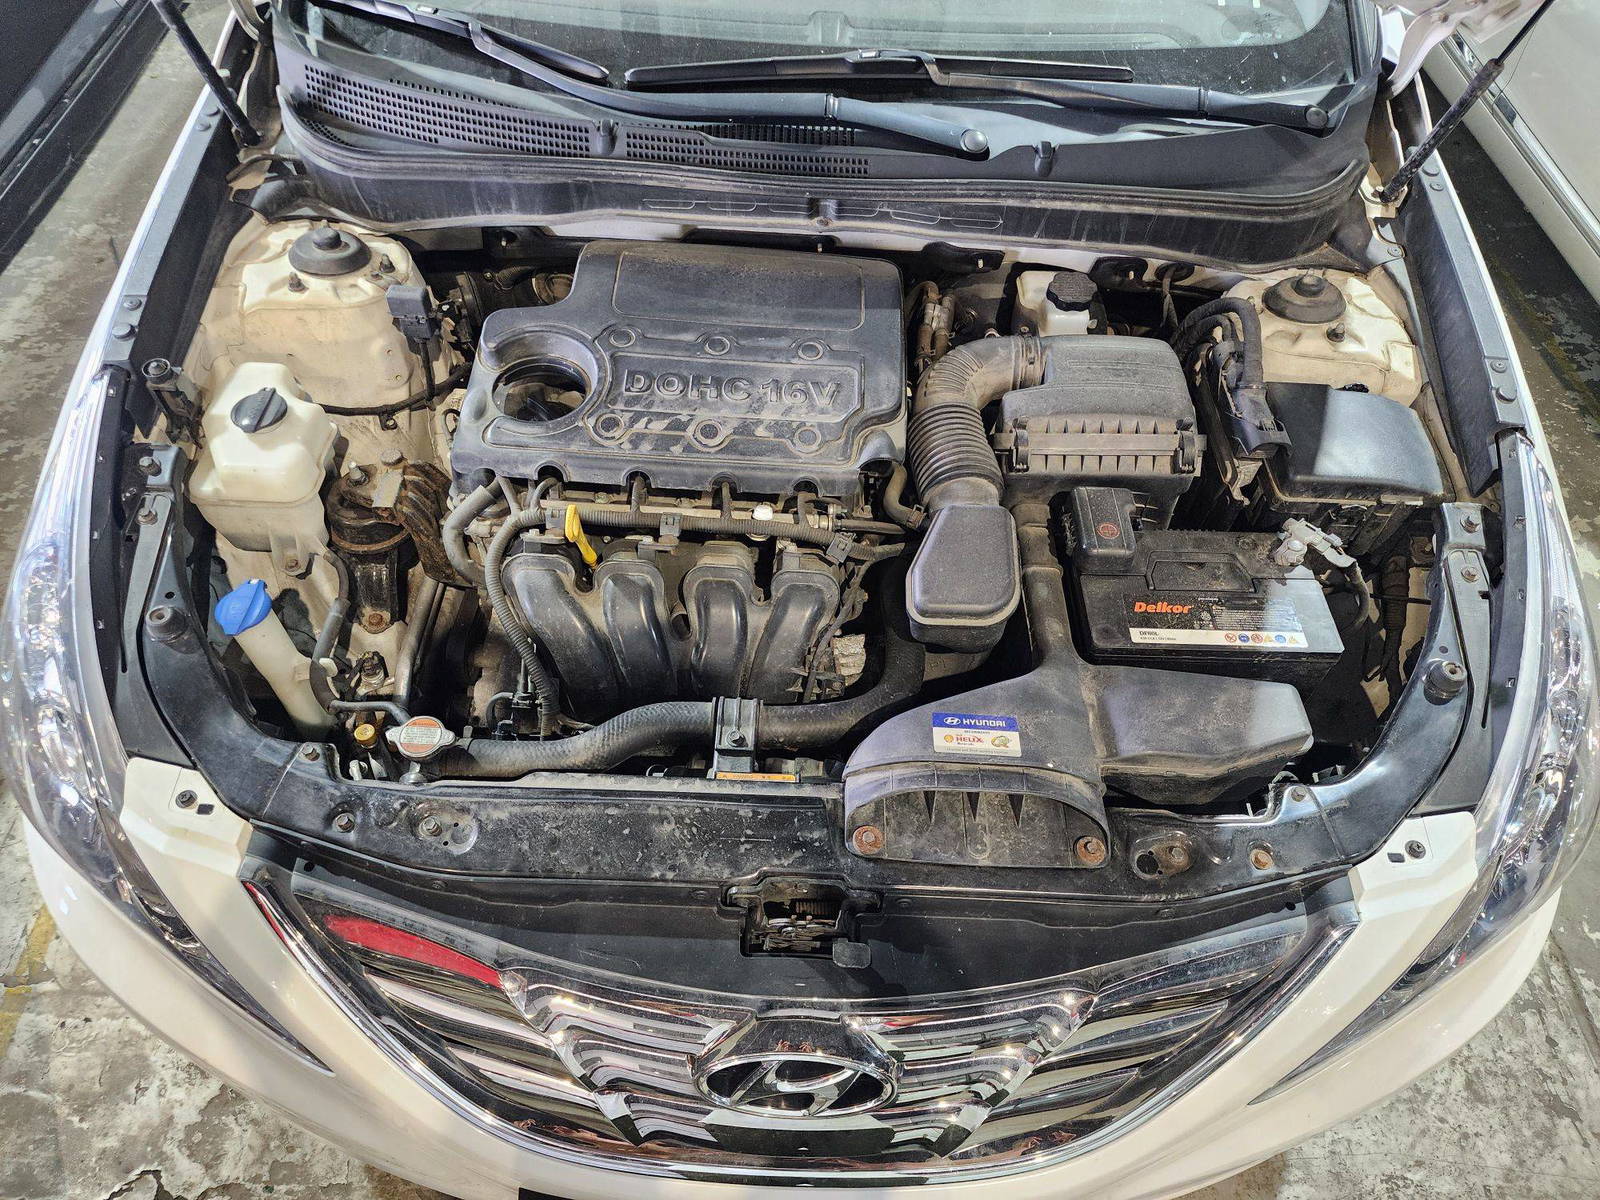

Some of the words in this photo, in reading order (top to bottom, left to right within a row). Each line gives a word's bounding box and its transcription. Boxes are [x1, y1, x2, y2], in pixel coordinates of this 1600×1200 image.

[623, 368, 753, 402] DOHC
[760, 377, 841, 407] 16V
[1134, 601, 1192, 614] Delkor
[963, 718, 1006, 727] HYUNDAI
[955, 735, 984, 743] HELIX
